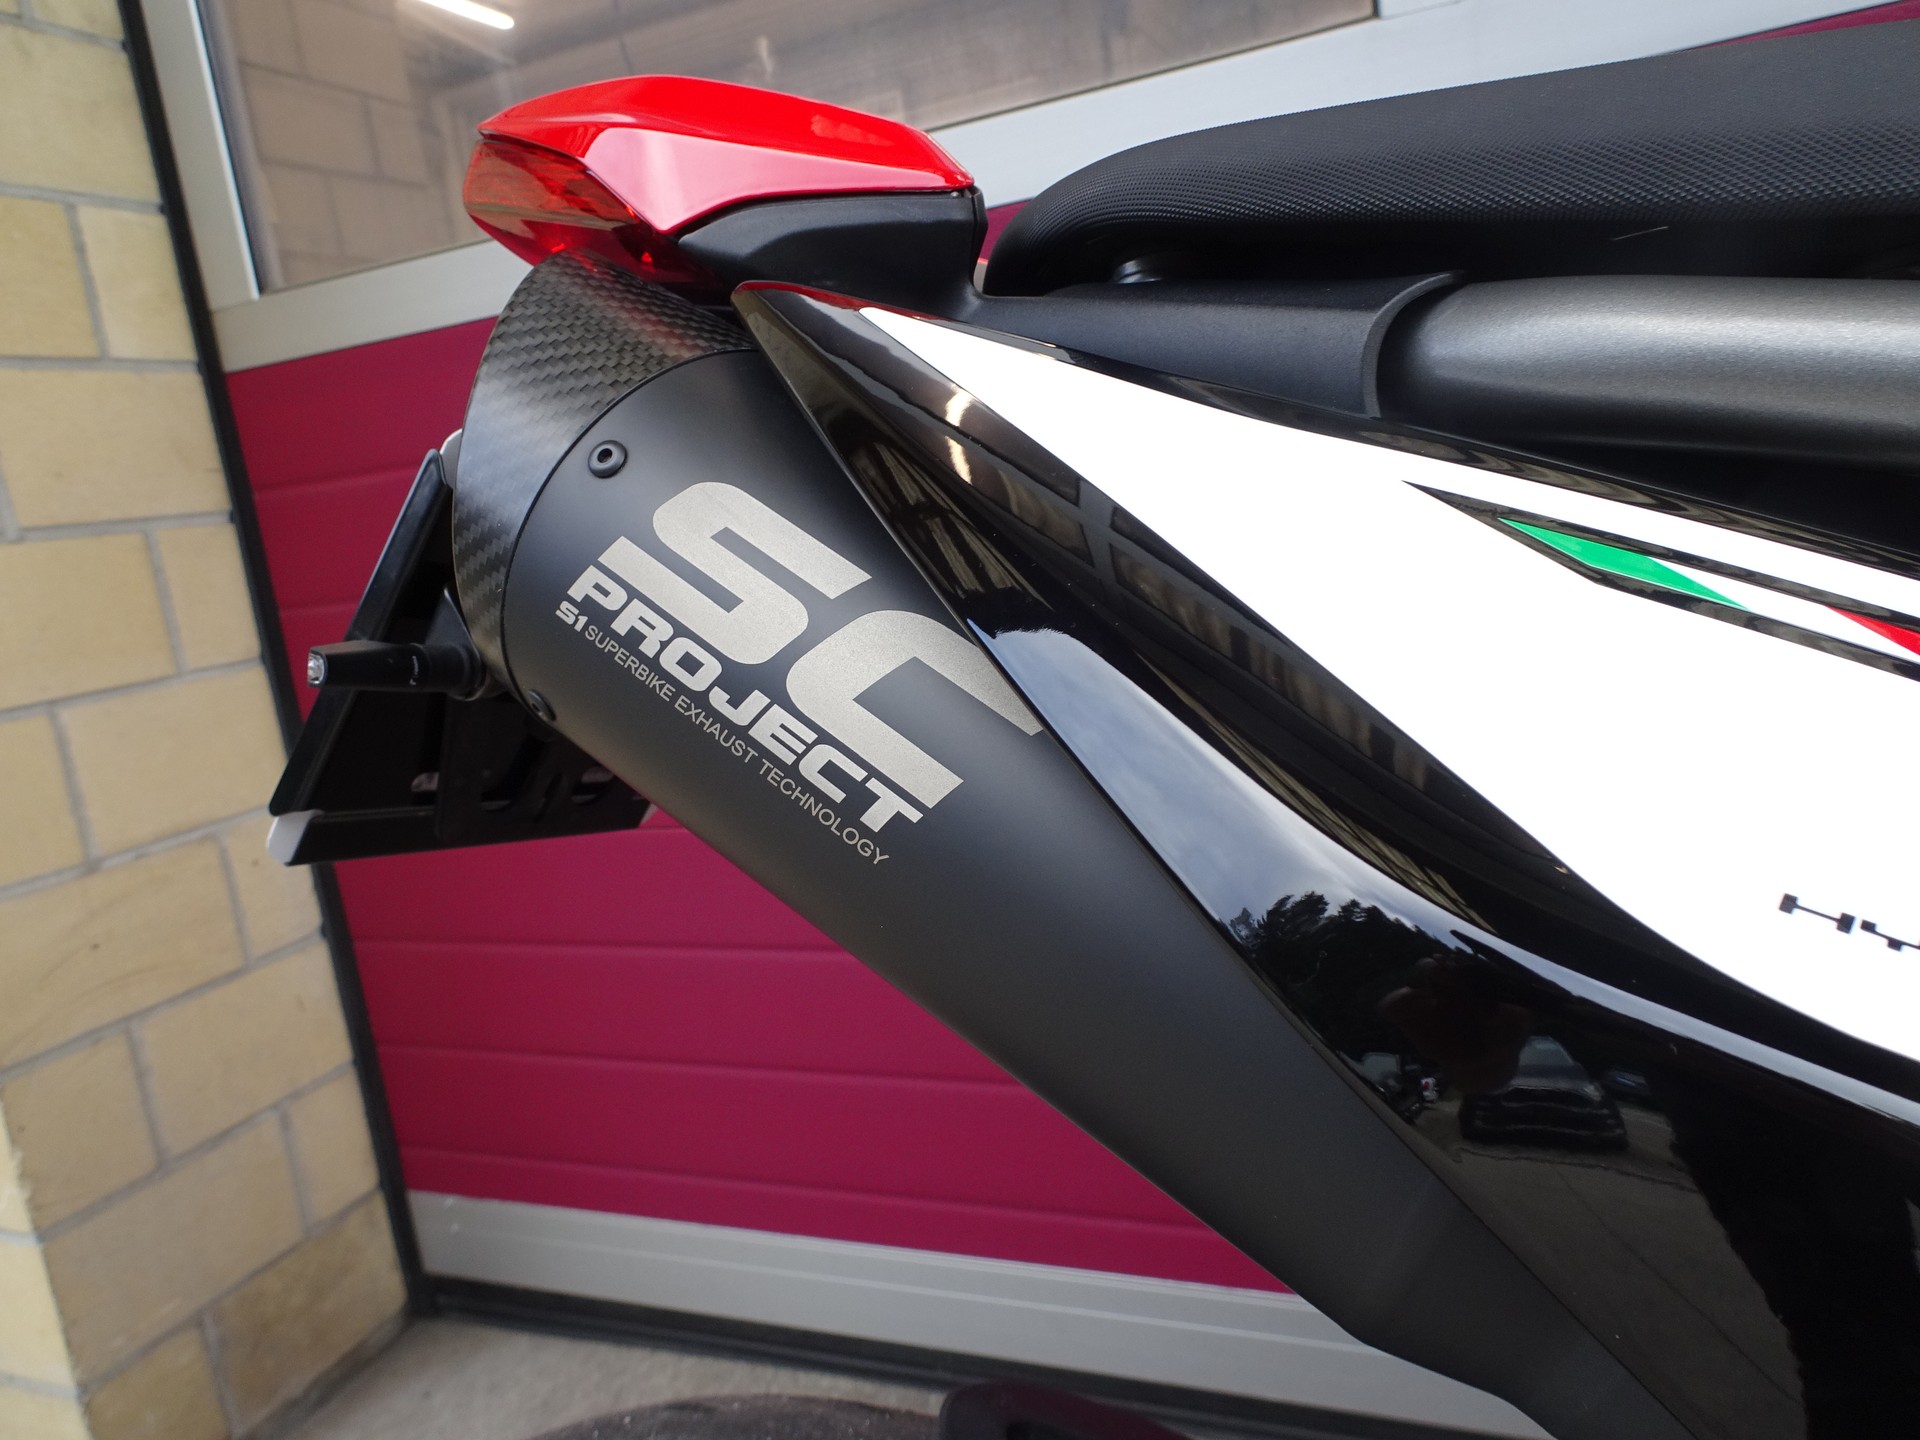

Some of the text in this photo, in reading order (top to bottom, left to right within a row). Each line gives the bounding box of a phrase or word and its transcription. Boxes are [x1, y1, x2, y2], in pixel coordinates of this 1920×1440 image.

[555, 600, 890, 865] S1 SUPERBIKE EXHAUST TECHNOLOGY
[566, 564, 924, 833] PROJECT
[597, 481, 1044, 809] SC
